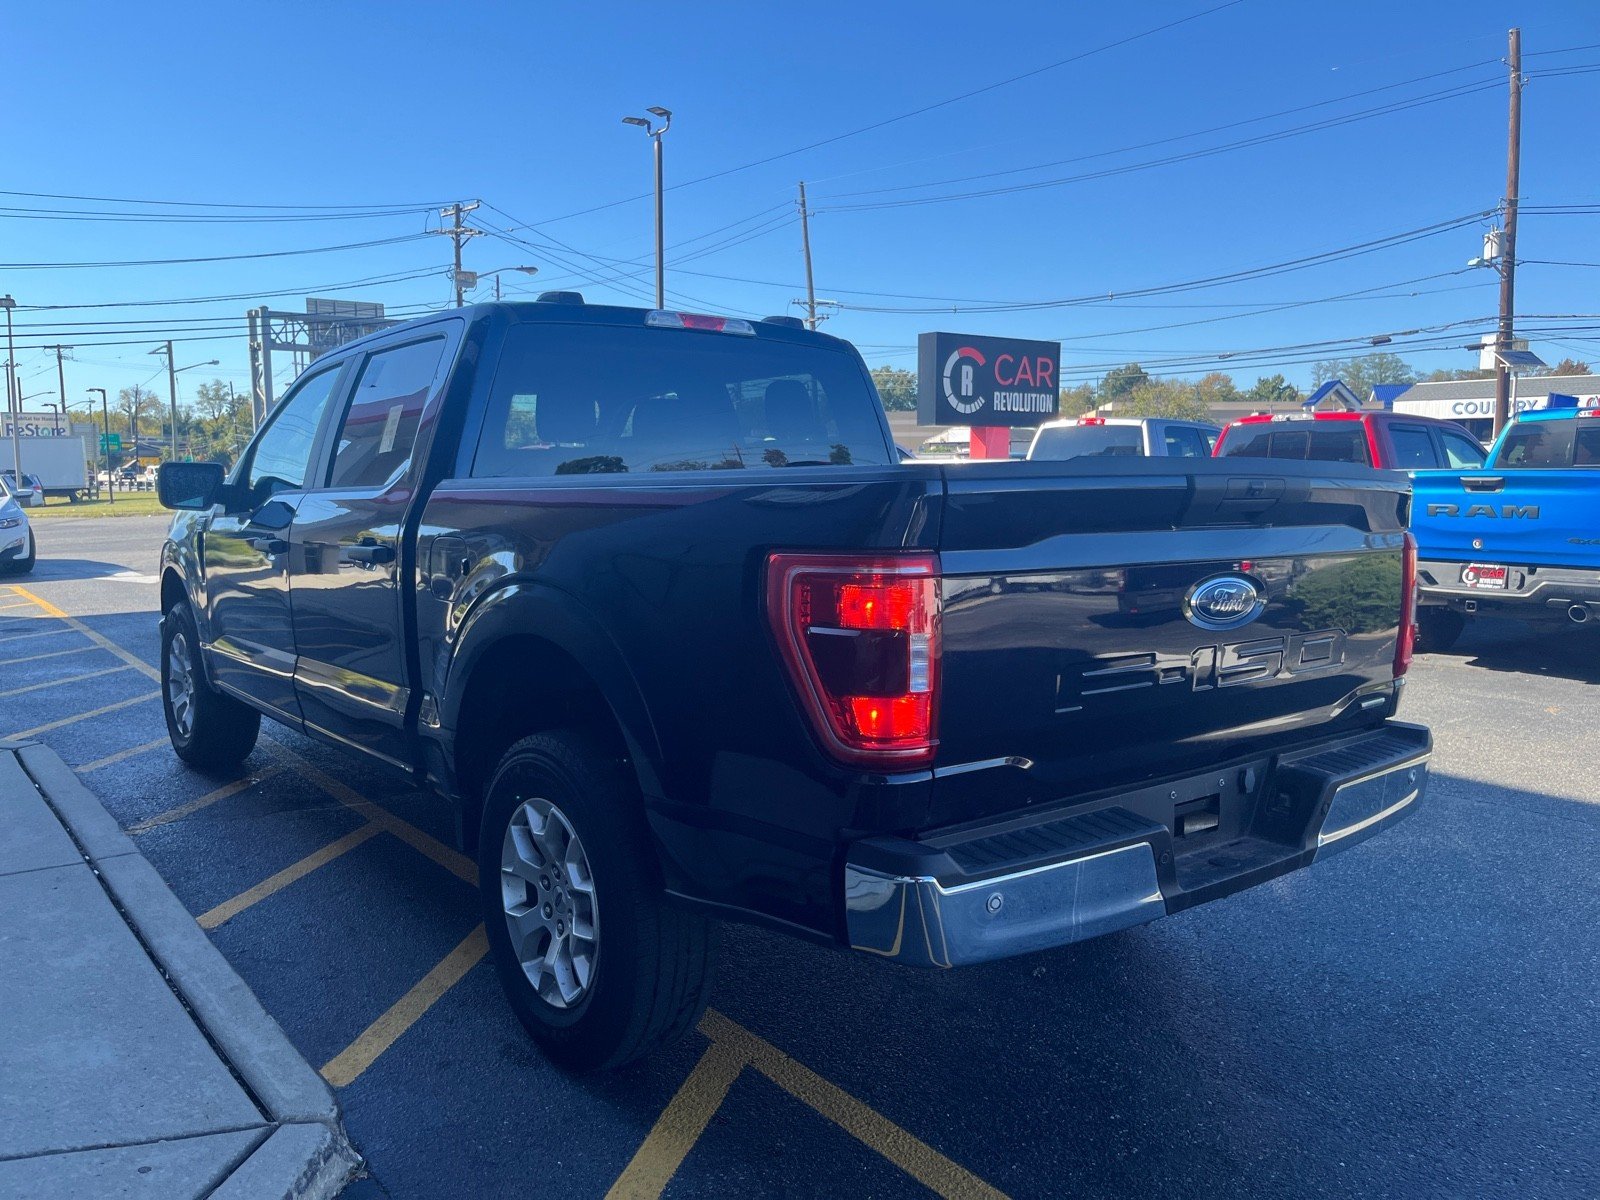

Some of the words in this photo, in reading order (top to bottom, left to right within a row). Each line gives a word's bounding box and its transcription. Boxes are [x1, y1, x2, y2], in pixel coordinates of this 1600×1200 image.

[994, 353, 1054, 388] CAR
[993, 391, 1053, 413] REVOLUTION
[1452, 399, 1538, 415] COURY
[5, 422, 66, 437] ReStore
[1427, 503, 1540, 520] RAM
[1480, 569, 1504, 578] CAR
[1210, 588, 1246, 612] Ford
[1054, 627, 1347, 714] F-150
